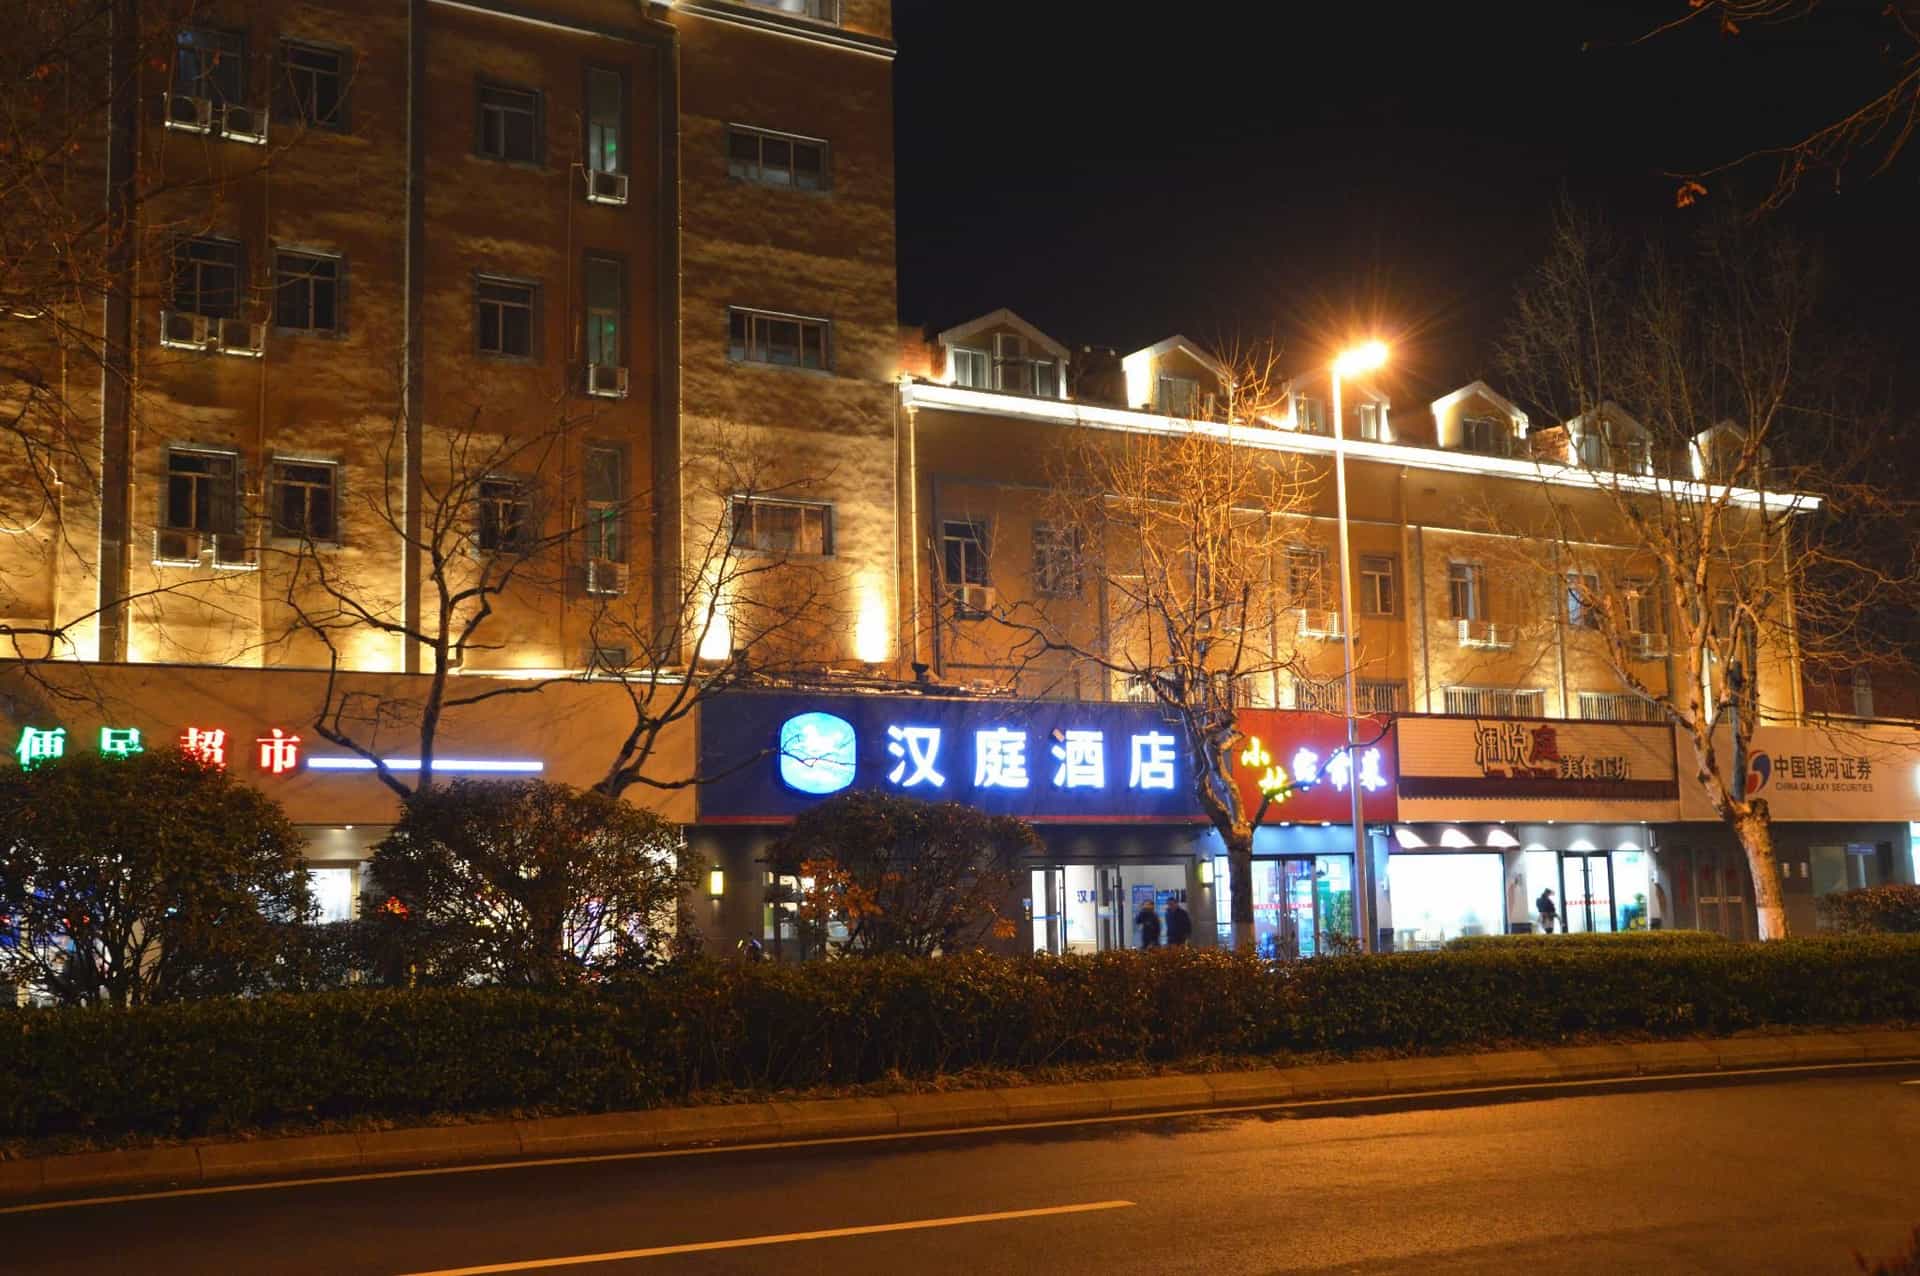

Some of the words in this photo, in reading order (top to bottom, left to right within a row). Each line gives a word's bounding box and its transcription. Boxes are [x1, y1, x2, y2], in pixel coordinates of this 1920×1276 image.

[886, 724, 1177, 790] 汉庭酒店
[1773, 754, 1872, 780] 中国银河证券
[1775, 783, 1798, 792] CHINA
[1800, 783, 1829, 792] GALAXY
[1831, 783, 1873, 793] SECURITIES
